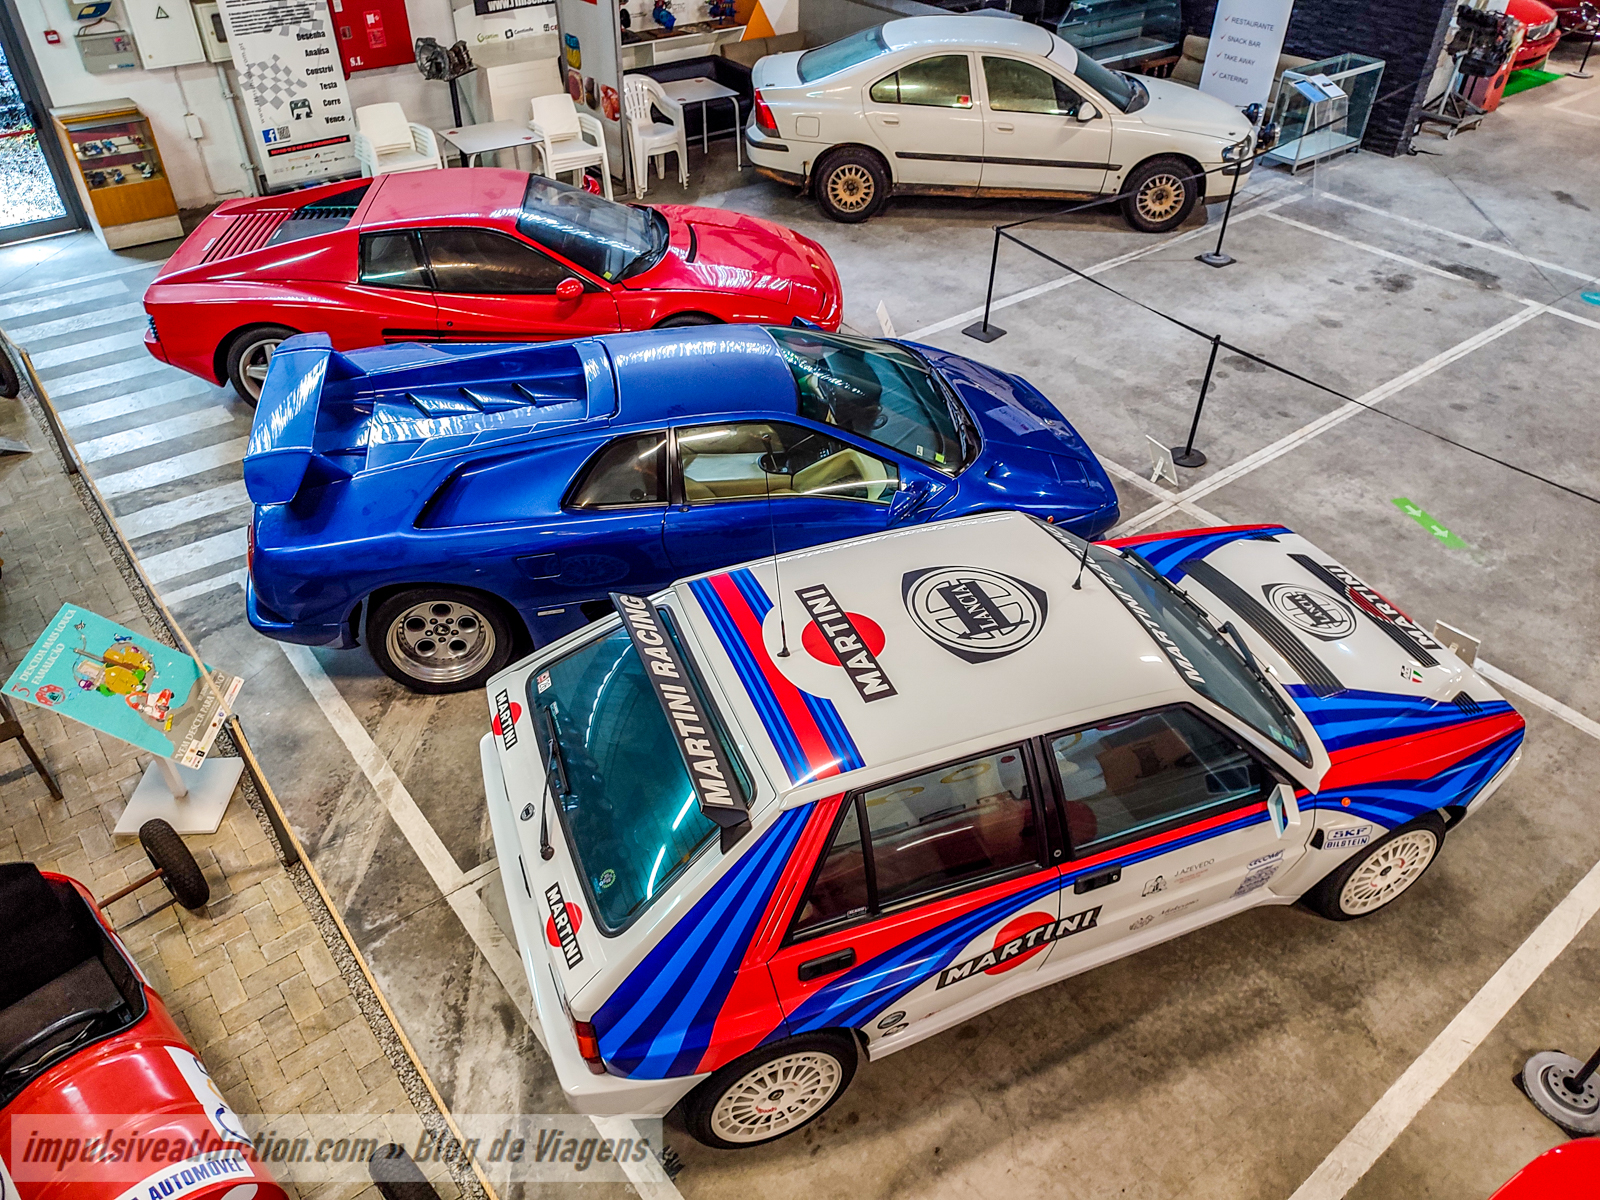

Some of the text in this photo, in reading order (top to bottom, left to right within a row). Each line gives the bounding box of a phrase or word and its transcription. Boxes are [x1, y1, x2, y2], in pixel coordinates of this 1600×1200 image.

[1231, 17, 1274, 31] RESTAURANTE
[296, 30, 326, 41] Desenha
[1227, 35, 1261, 48] SNACK BAR
[305, 47, 330, 57] Analisa
[1223, 53, 1255, 66] TAKE AWAY
[306, 64, 334, 76] Constrói
[1218, 72, 1248, 85] CATERING
[320, 81, 338, 90] Testa
[323, 98, 341, 107] Corre
[324, 115, 346, 124] Vence
[950, 584, 999, 631] LANCIA
[1328, 566, 1436, 647] MARTINI
[801, 589, 890, 697] MARTINI
[1115, 589, 1205, 684] MARTINI
[18, 647, 47, 682] DESCIDA
[41, 630, 60, 649] MAIS
[619, 595, 734, 806] MARTINI RACING
[184, 712, 205, 740] DESCER
[199, 694, 215, 713] PARA
[497, 692, 517, 748] MARTINI
[1332, 827, 1368, 839] SKF
[1327, 837, 1368, 849] BILSTEIN
[547, 886, 582, 966] MARTINI
[944, 909, 1096, 986] MARTINI
